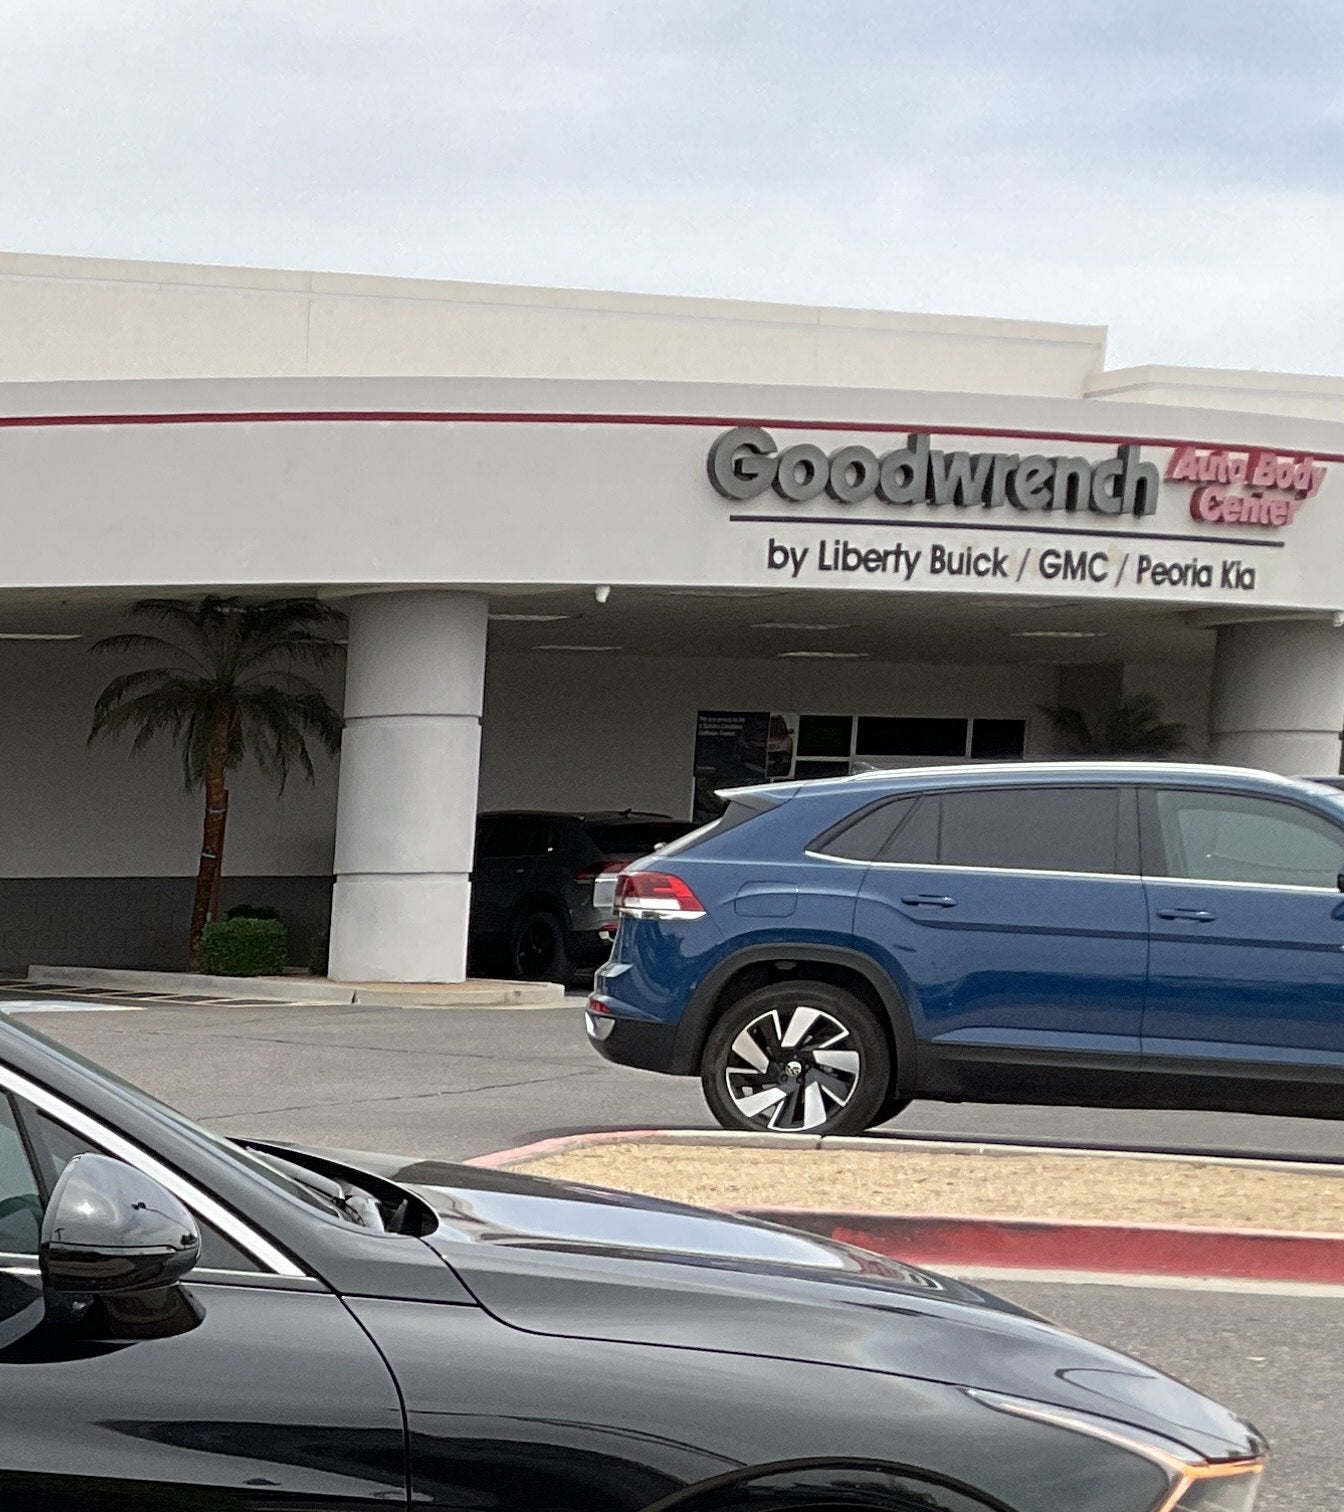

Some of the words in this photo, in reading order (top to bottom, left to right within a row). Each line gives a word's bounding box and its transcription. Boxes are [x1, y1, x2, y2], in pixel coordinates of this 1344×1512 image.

[707, 425, 1159, 519] Goodwrench
[1166, 446, 1248, 483] Auto
[1249, 452, 1327, 497] Body
[1190, 486, 1303, 526] Center
[767, 538, 809, 578] by
[818, 539, 922, 581] Liberty
[929, 543, 1009, 577] Buick
[1015, 548, 1031, 582] /
[1039, 549, 1110, 582] GMC
[1115, 553, 1129, 587] /
[1136, 554, 1213, 588] Peoria
[1220, 560, 1255, 590] Kia
